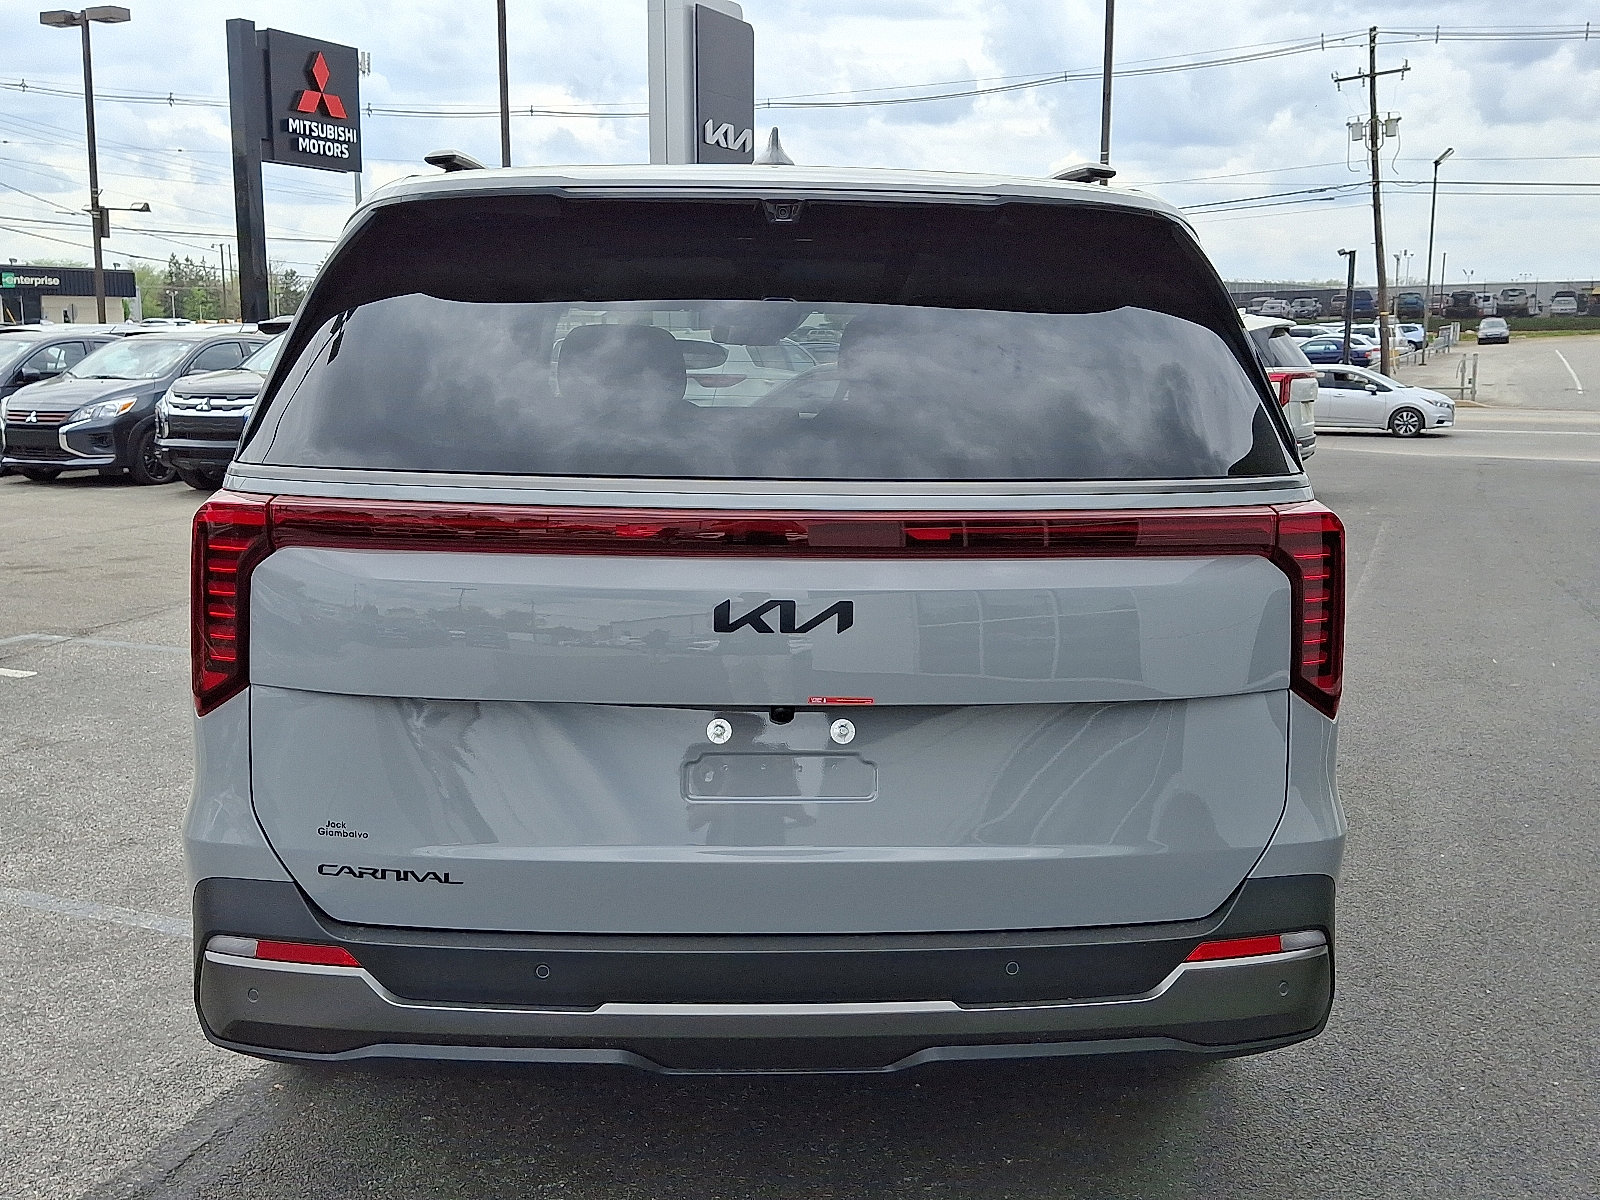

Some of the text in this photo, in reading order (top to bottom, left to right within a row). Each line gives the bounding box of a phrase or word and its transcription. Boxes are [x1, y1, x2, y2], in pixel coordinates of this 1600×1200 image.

[288, 118, 357, 143] MITSUBISHI
[704, 119, 753, 153] KIA
[298, 137, 350, 159] MOTORS
[4, 275, 60, 287] enterprise
[713, 599, 854, 635] KIA
[317, 827, 369, 839] Giambalvo
[325, 820, 347, 829] Jack
[317, 863, 464, 885] CARNIVAL
